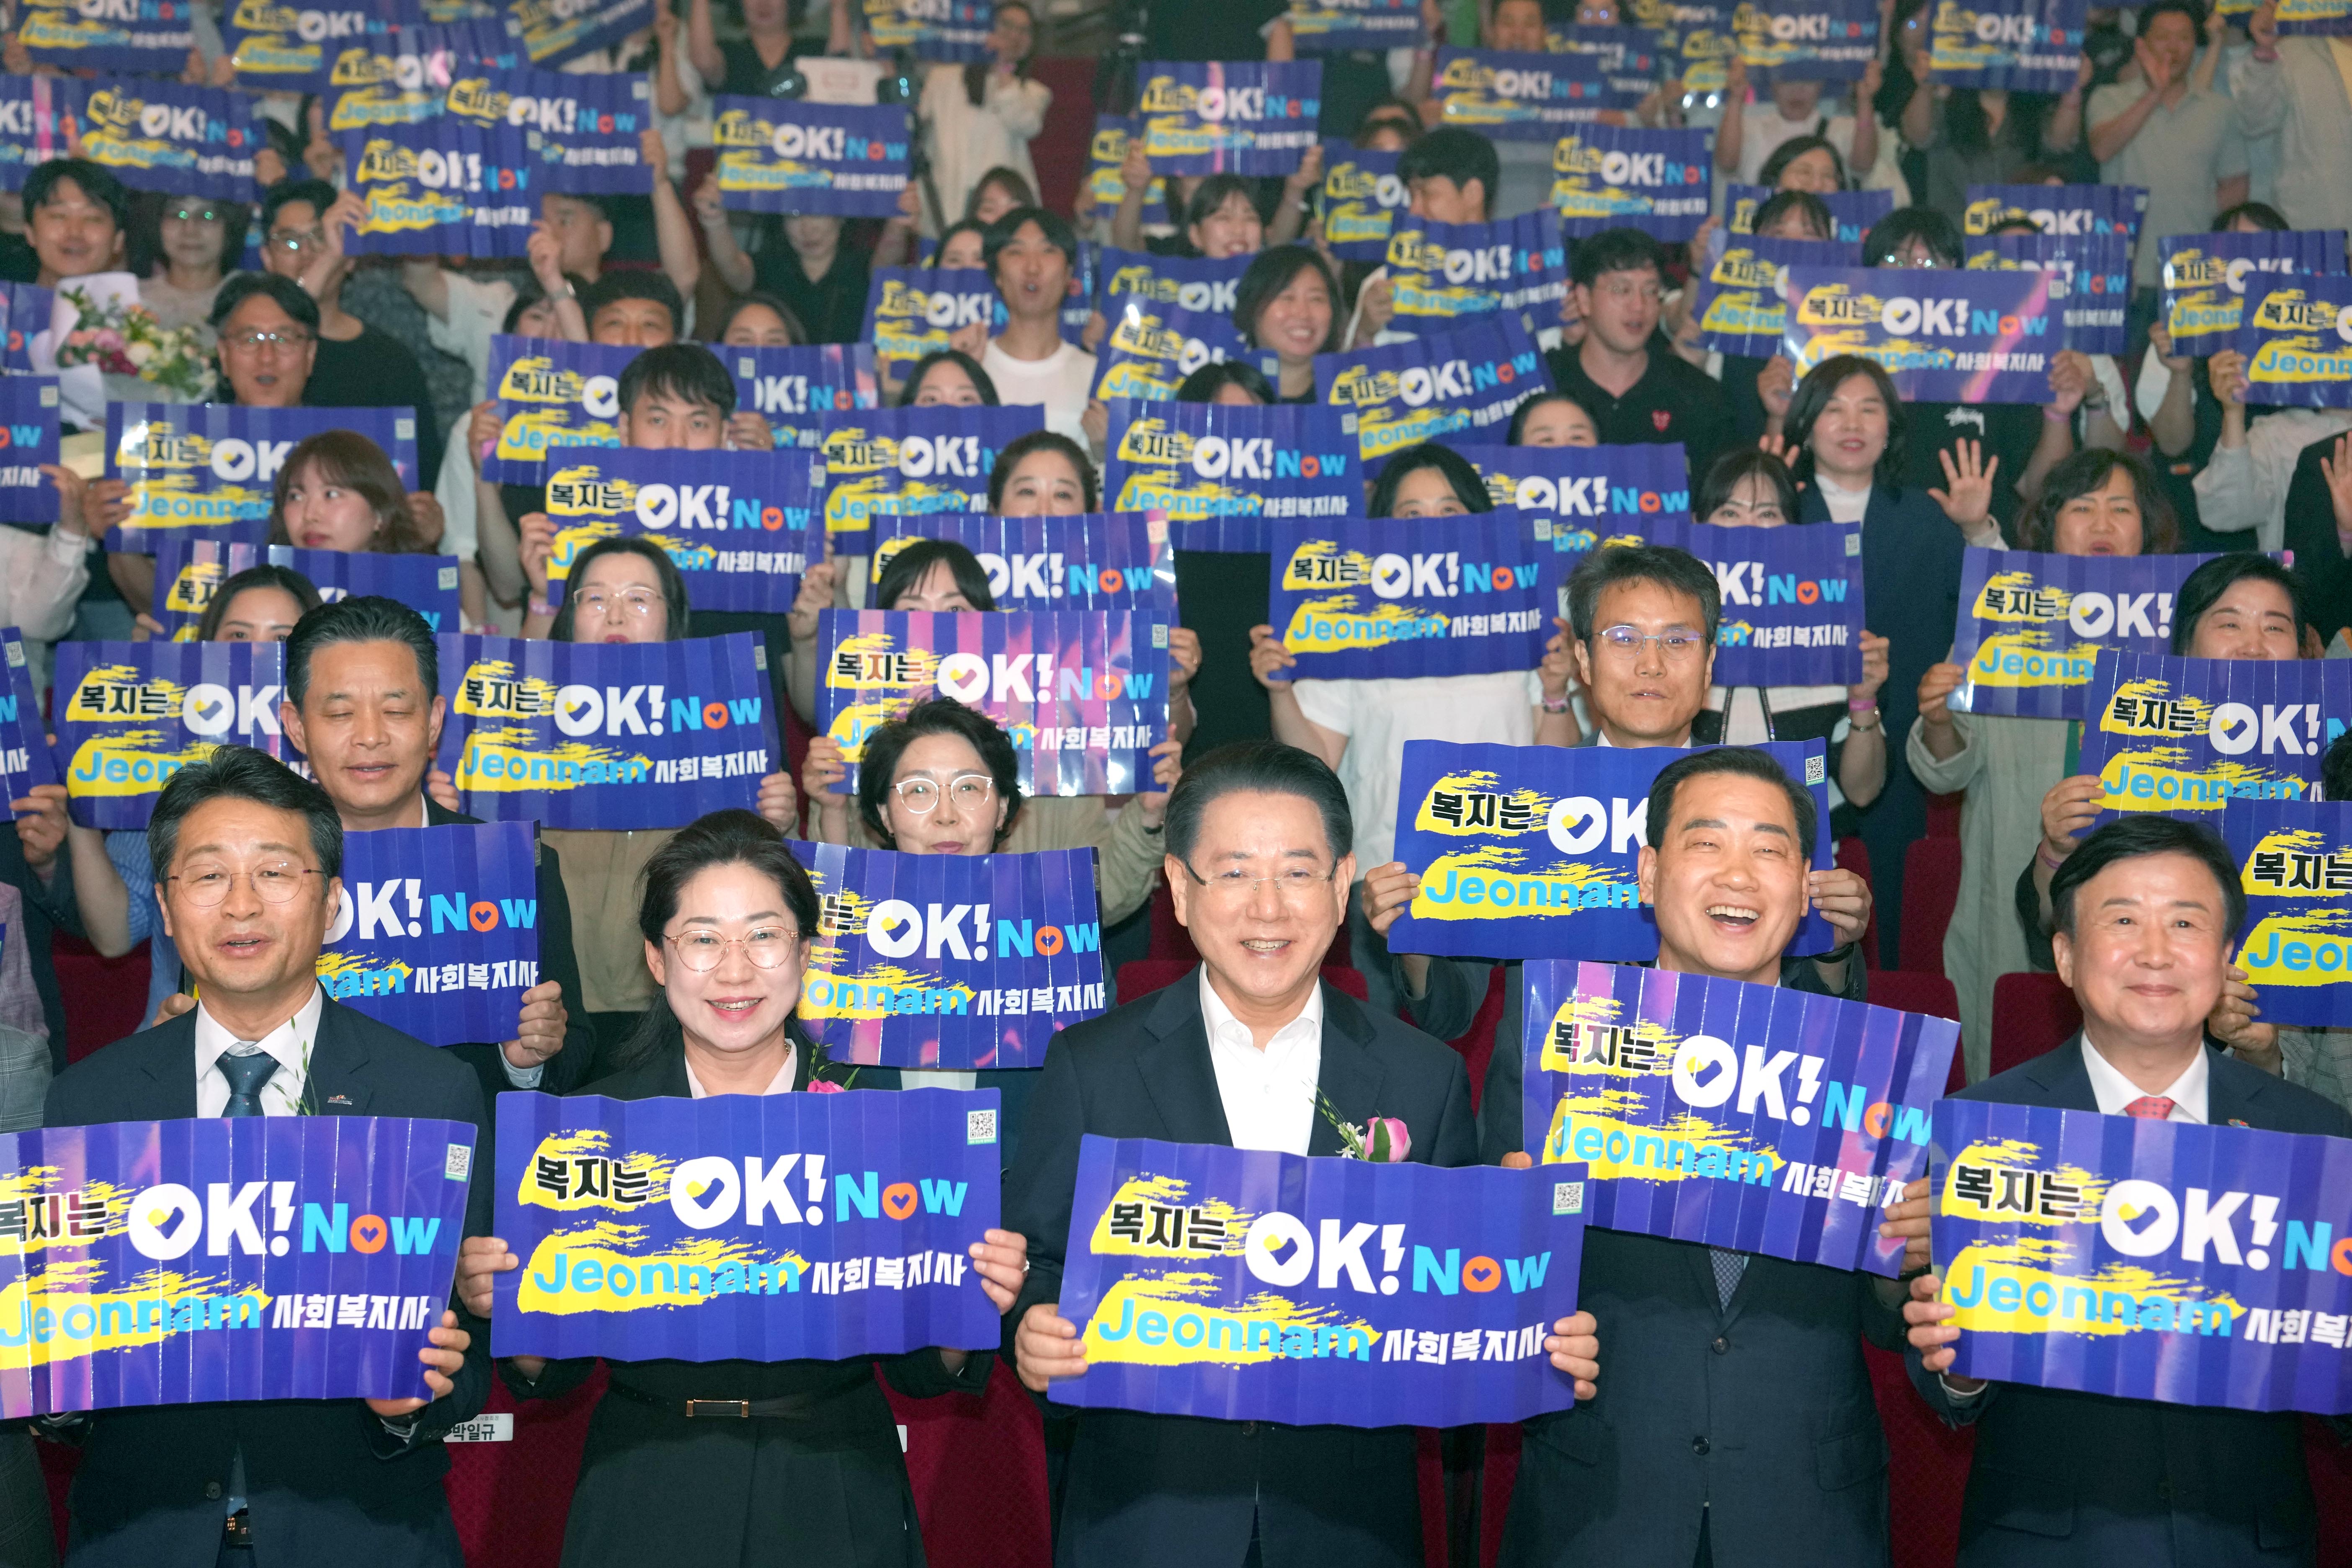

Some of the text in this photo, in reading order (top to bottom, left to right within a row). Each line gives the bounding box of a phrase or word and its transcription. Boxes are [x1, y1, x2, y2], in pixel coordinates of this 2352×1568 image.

[140, 103, 206, 143] OK!
[508, 97, 576, 133] OK!
[578, 109, 637, 133] Now
[1197, 87, 1264, 120] OK!
[773, 123, 845, 161] OK!
[846, 138, 907, 160] Now
[1600, 151, 1664, 187] OK!
[1444, 246, 1511, 283] OK!
[2076, 270, 2127, 294] Now
[925, 292, 992, 327] OK!
[1810, 296, 2048, 337] 복지는 OK! Now
[2264, 302, 2327, 325] 복지는
[1398, 360, 1473, 406] OK!
[1473, 352, 1537, 390] Now
[827, 435, 980, 478] 복지는 OK!
[1192, 436, 1274, 480] OK!
[1276, 450, 1346, 478] Now
[550, 483, 810, 532] 복지는 OK! Now
[1125, 487, 1259, 517] Jeonnam
[1611, 487, 1690, 515] Now
[1068, 563, 1153, 597] Now
[1294, 552, 1539, 599] 복지는 OK! Now
[1768, 573, 1848, 606] Now
[1292, 608, 1542, 642] Jeonnam 사회복지사
[1984, 587, 2173, 640] 복지는 OK!
[1753, 624, 1848, 650] 사회복지사
[837, 651, 1154, 704] 복지는 OK! Now
[1979, 647, 2093, 679] Jeonn
[80, 683, 290, 735] 복지는 OK
[465, 677, 762, 737] 복지는 OK! Now
[2112, 696, 2321, 756] 복지는 OK!
[1040, 724, 1152, 751] 사회복지사
[463, 746, 769, 785] Jeonnam 사회복지사
[1430, 790, 1649, 855] 복지는 OK
[431, 892, 537, 935] Now
[866, 898, 1100, 962] OK! Now
[415, 959, 539, 995] 사회복지사
[801, 978, 1106, 1016] onnam 사회복지사
[1554, 1020, 1933, 1148] 복지는 OK! Now
[1552, 1115, 1774, 1187] Jeonnam
[534, 1153, 968, 1230] 복지는 OK! Now
[128, 1181, 296, 1261] OK!
[301, 1202, 441, 1256] Now
[1953, 1164, 2082, 1219] 복지는
[2101, 1179, 2281, 1271] OK!
[1110, 1202, 1552, 1296] 복지는 OK! Now
[533, 1250, 968, 1296] Jeonnam 사회복지사
[0, 1293, 430, 1348] Jeonnam 사회복지사
[1950, 1264, 2352, 1349] Jeonnam 사회복
[1098, 1298, 1547, 1365] Jeonnam 사회복지사
[452, 1424, 495, 1441] 박일규
